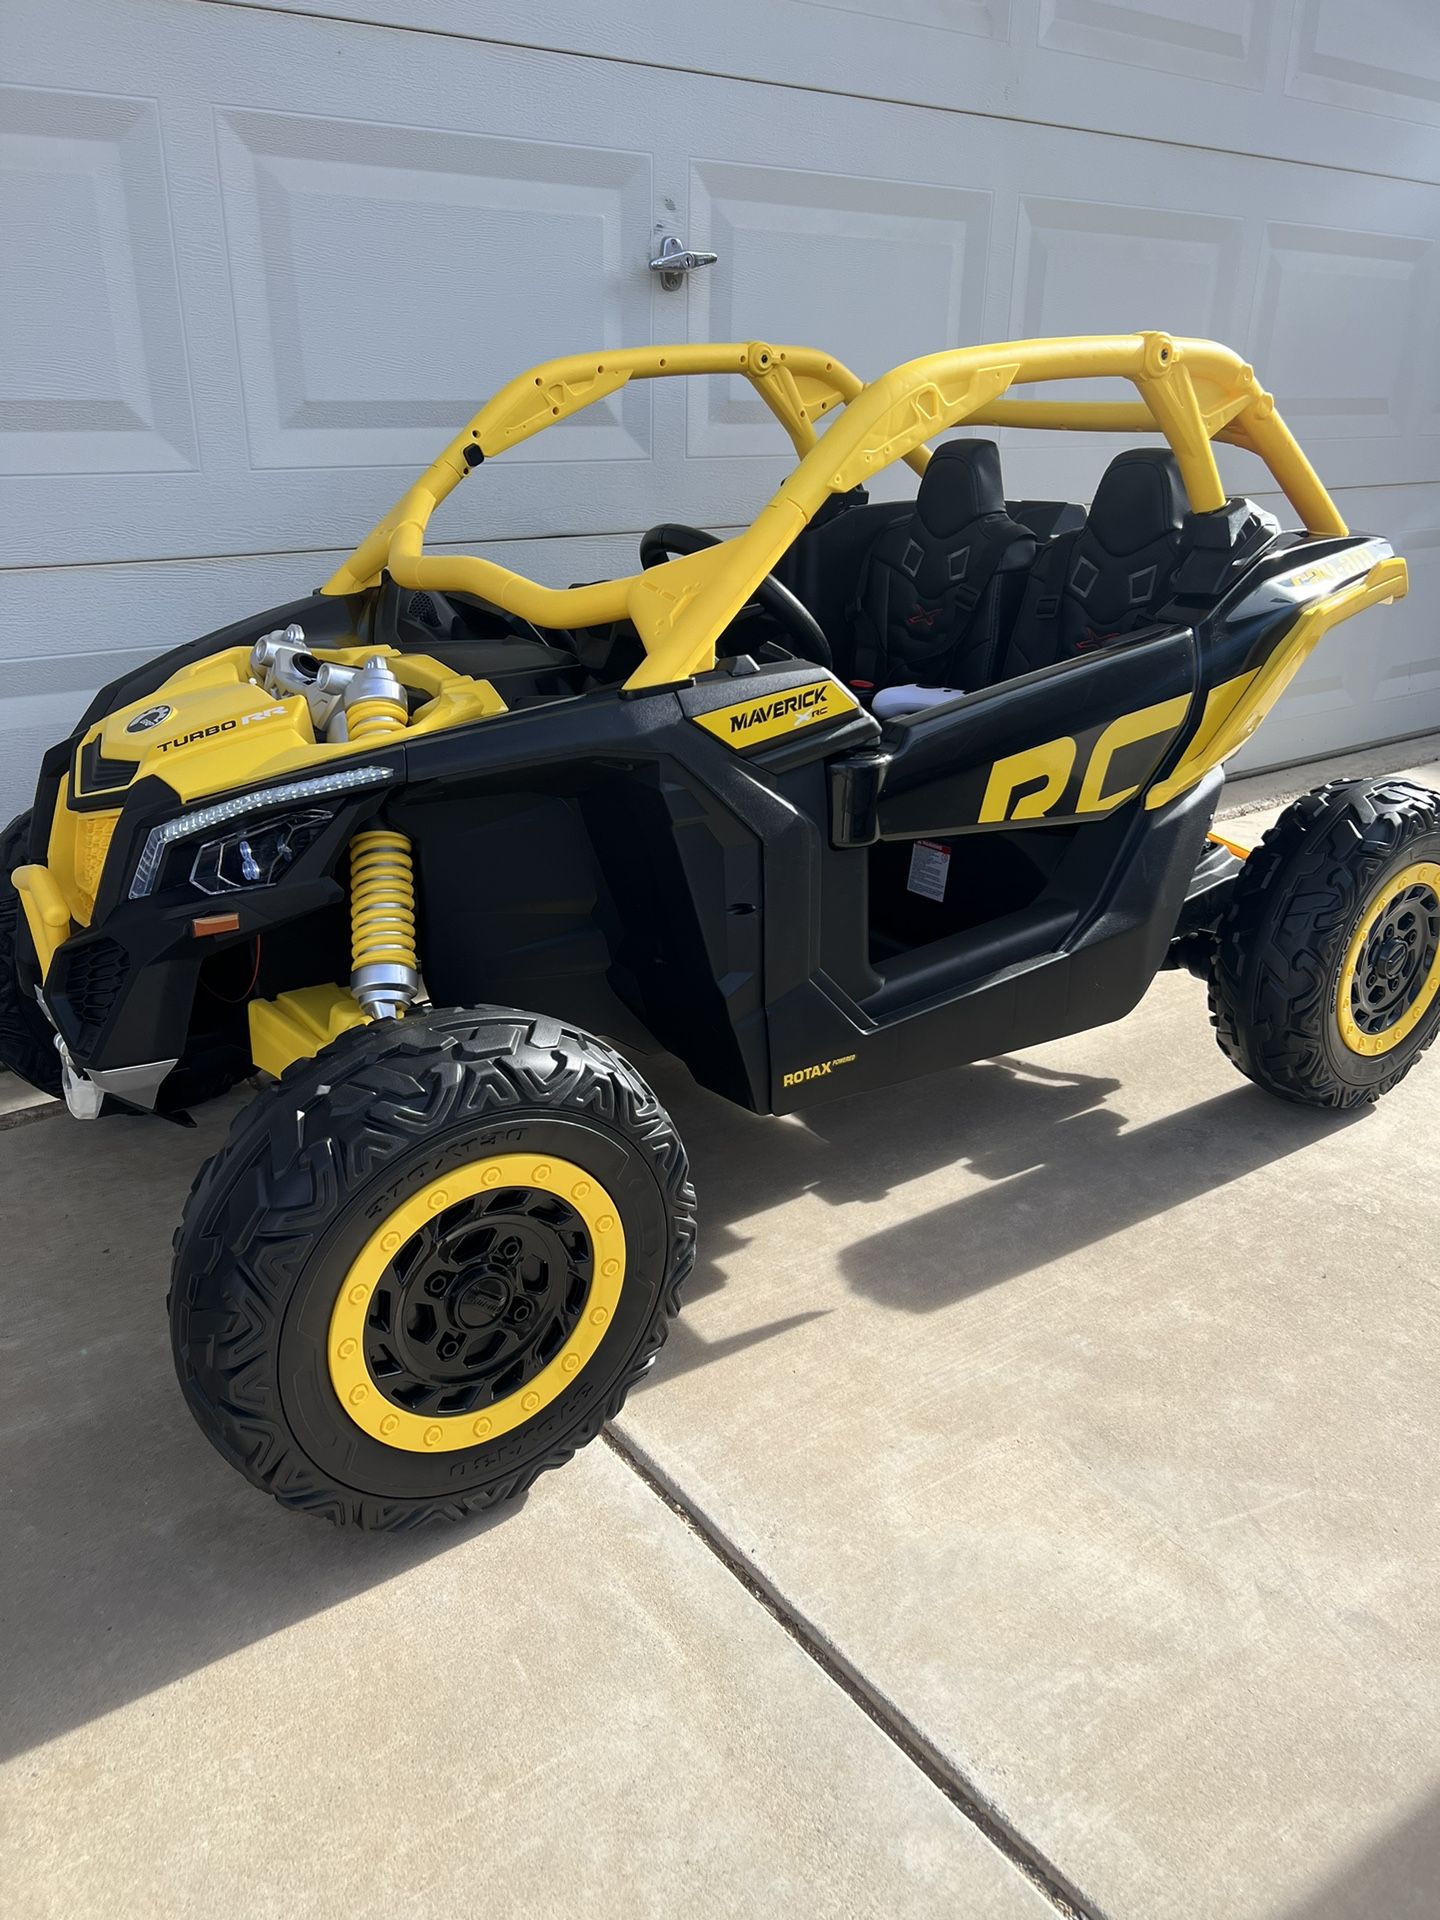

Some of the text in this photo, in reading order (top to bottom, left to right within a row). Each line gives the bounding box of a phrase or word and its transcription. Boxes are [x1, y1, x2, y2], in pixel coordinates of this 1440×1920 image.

[157, 719, 237, 752] TURBO
[241, 705, 288, 726] RR
[729, 685, 828, 733] MAVERICK
[977, 691, 1193, 824] RC
[783, 1061, 832, 1087] ROTAX
